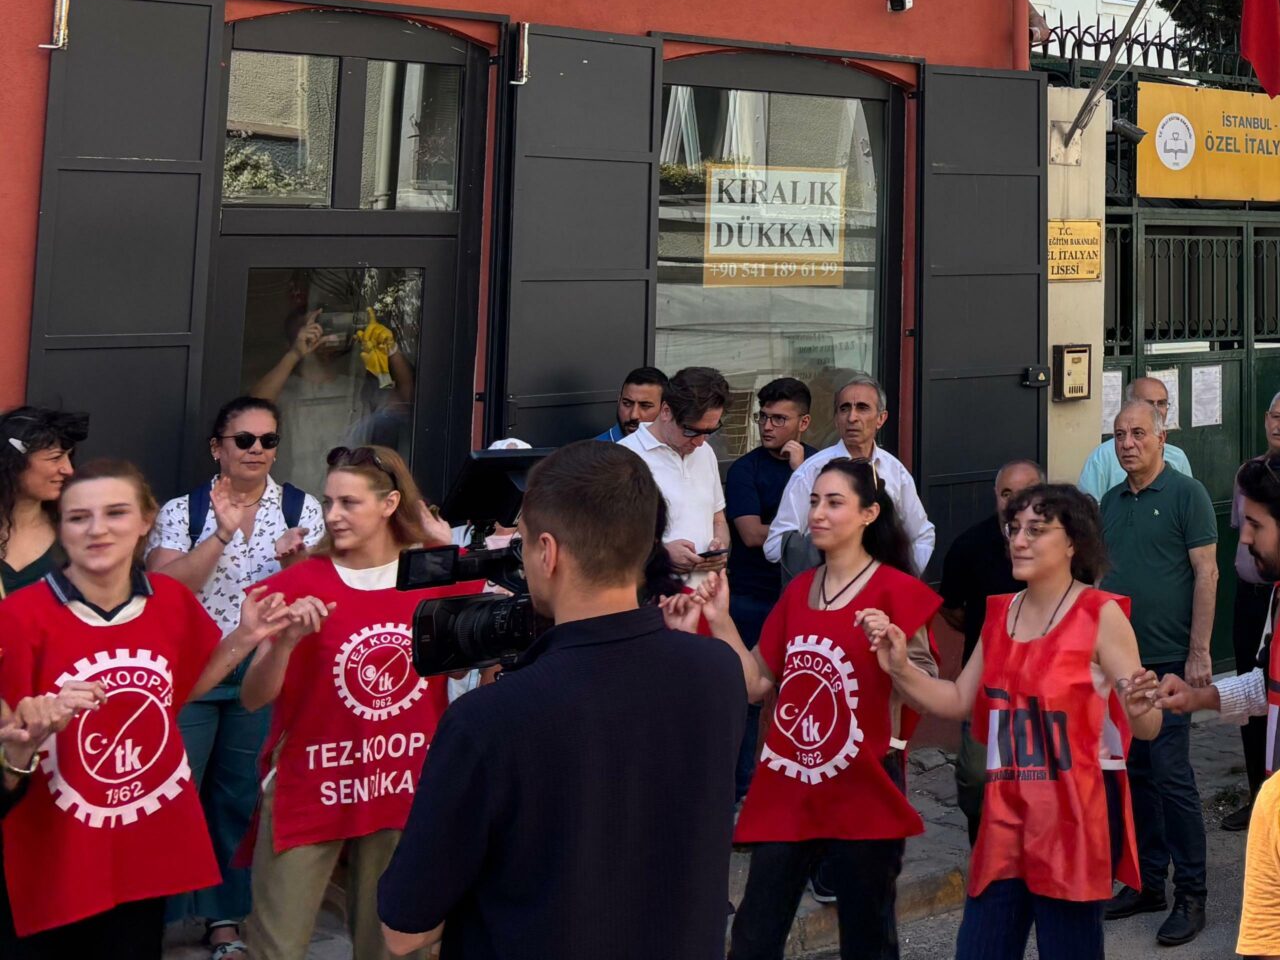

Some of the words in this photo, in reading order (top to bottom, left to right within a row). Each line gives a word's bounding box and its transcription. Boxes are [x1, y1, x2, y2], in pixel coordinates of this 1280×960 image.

[1221, 111, 1273, 131] İSTANBUL
[1204, 130, 1241, 154] ÖZEL
[715, 172, 837, 206] KİRALIK
[713, 215, 836, 248] DÜKKAN
[1057, 227, 1073, 236] T.C.
[1058, 248, 1099, 261] İTALYAN
[709, 262, 737, 278] +90
[741, 262, 766, 278] 541
[773, 261, 797, 278] 189
[801, 260, 816, 277] 61
[1050, 262, 1080, 275] LİSESİ
[347, 643, 369, 670] TEZ
[379, 672, 394, 692] tk
[372, 696, 392, 708] 1962
[801, 714, 821, 742] tk
[114, 738, 142, 774] tk
[796, 751, 823, 766] 1962
